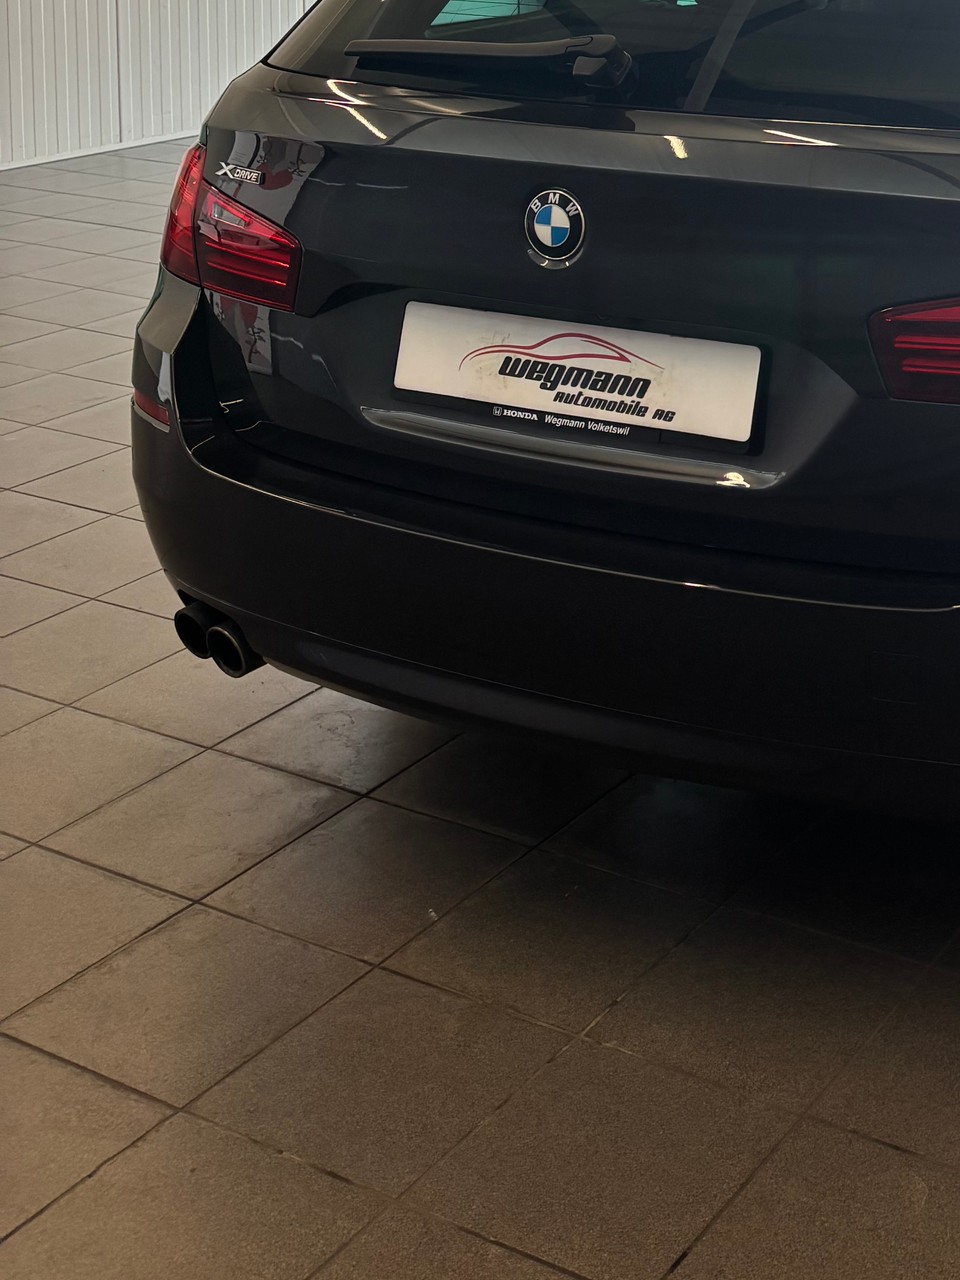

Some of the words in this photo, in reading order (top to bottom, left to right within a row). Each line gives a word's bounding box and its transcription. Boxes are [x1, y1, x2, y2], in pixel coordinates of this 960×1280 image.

[531, 192, 579, 217] BMW
[497, 356, 652, 400] wegmann
[503, 409, 539, 421] HONDA
[544, 414, 585, 430] Wegmann
[587, 420, 631, 436] Volketswil
[652, 409, 677, 423] AG
